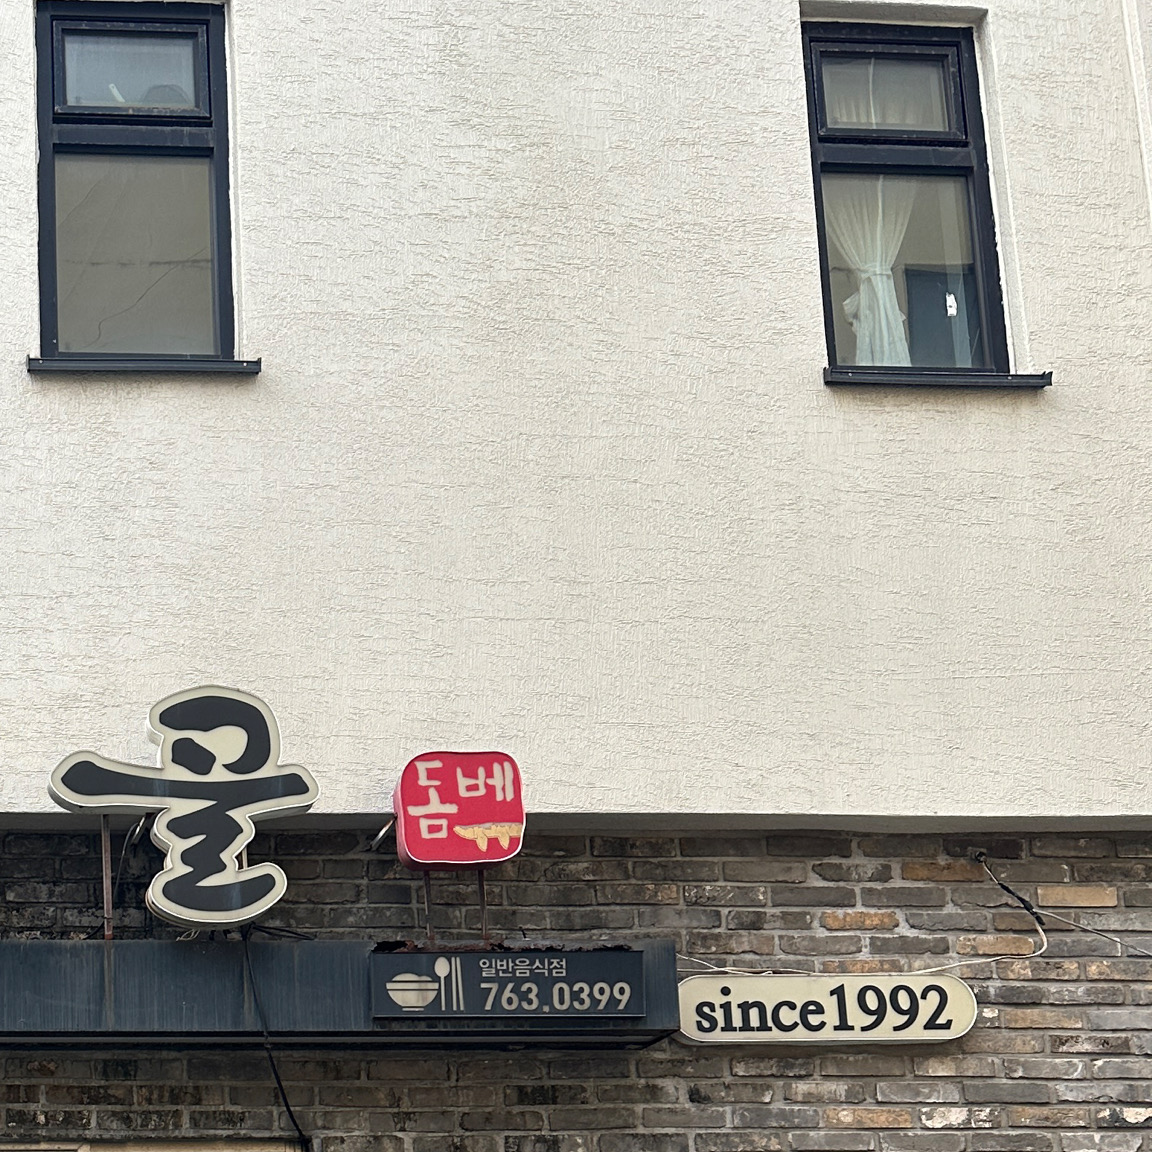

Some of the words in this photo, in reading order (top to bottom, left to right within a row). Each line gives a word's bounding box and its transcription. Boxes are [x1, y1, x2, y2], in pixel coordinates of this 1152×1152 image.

[407, 759, 515, 841] 돔베
[479, 957, 567, 978] 일반음식점
[480, 981, 631, 1013] 763.0399
